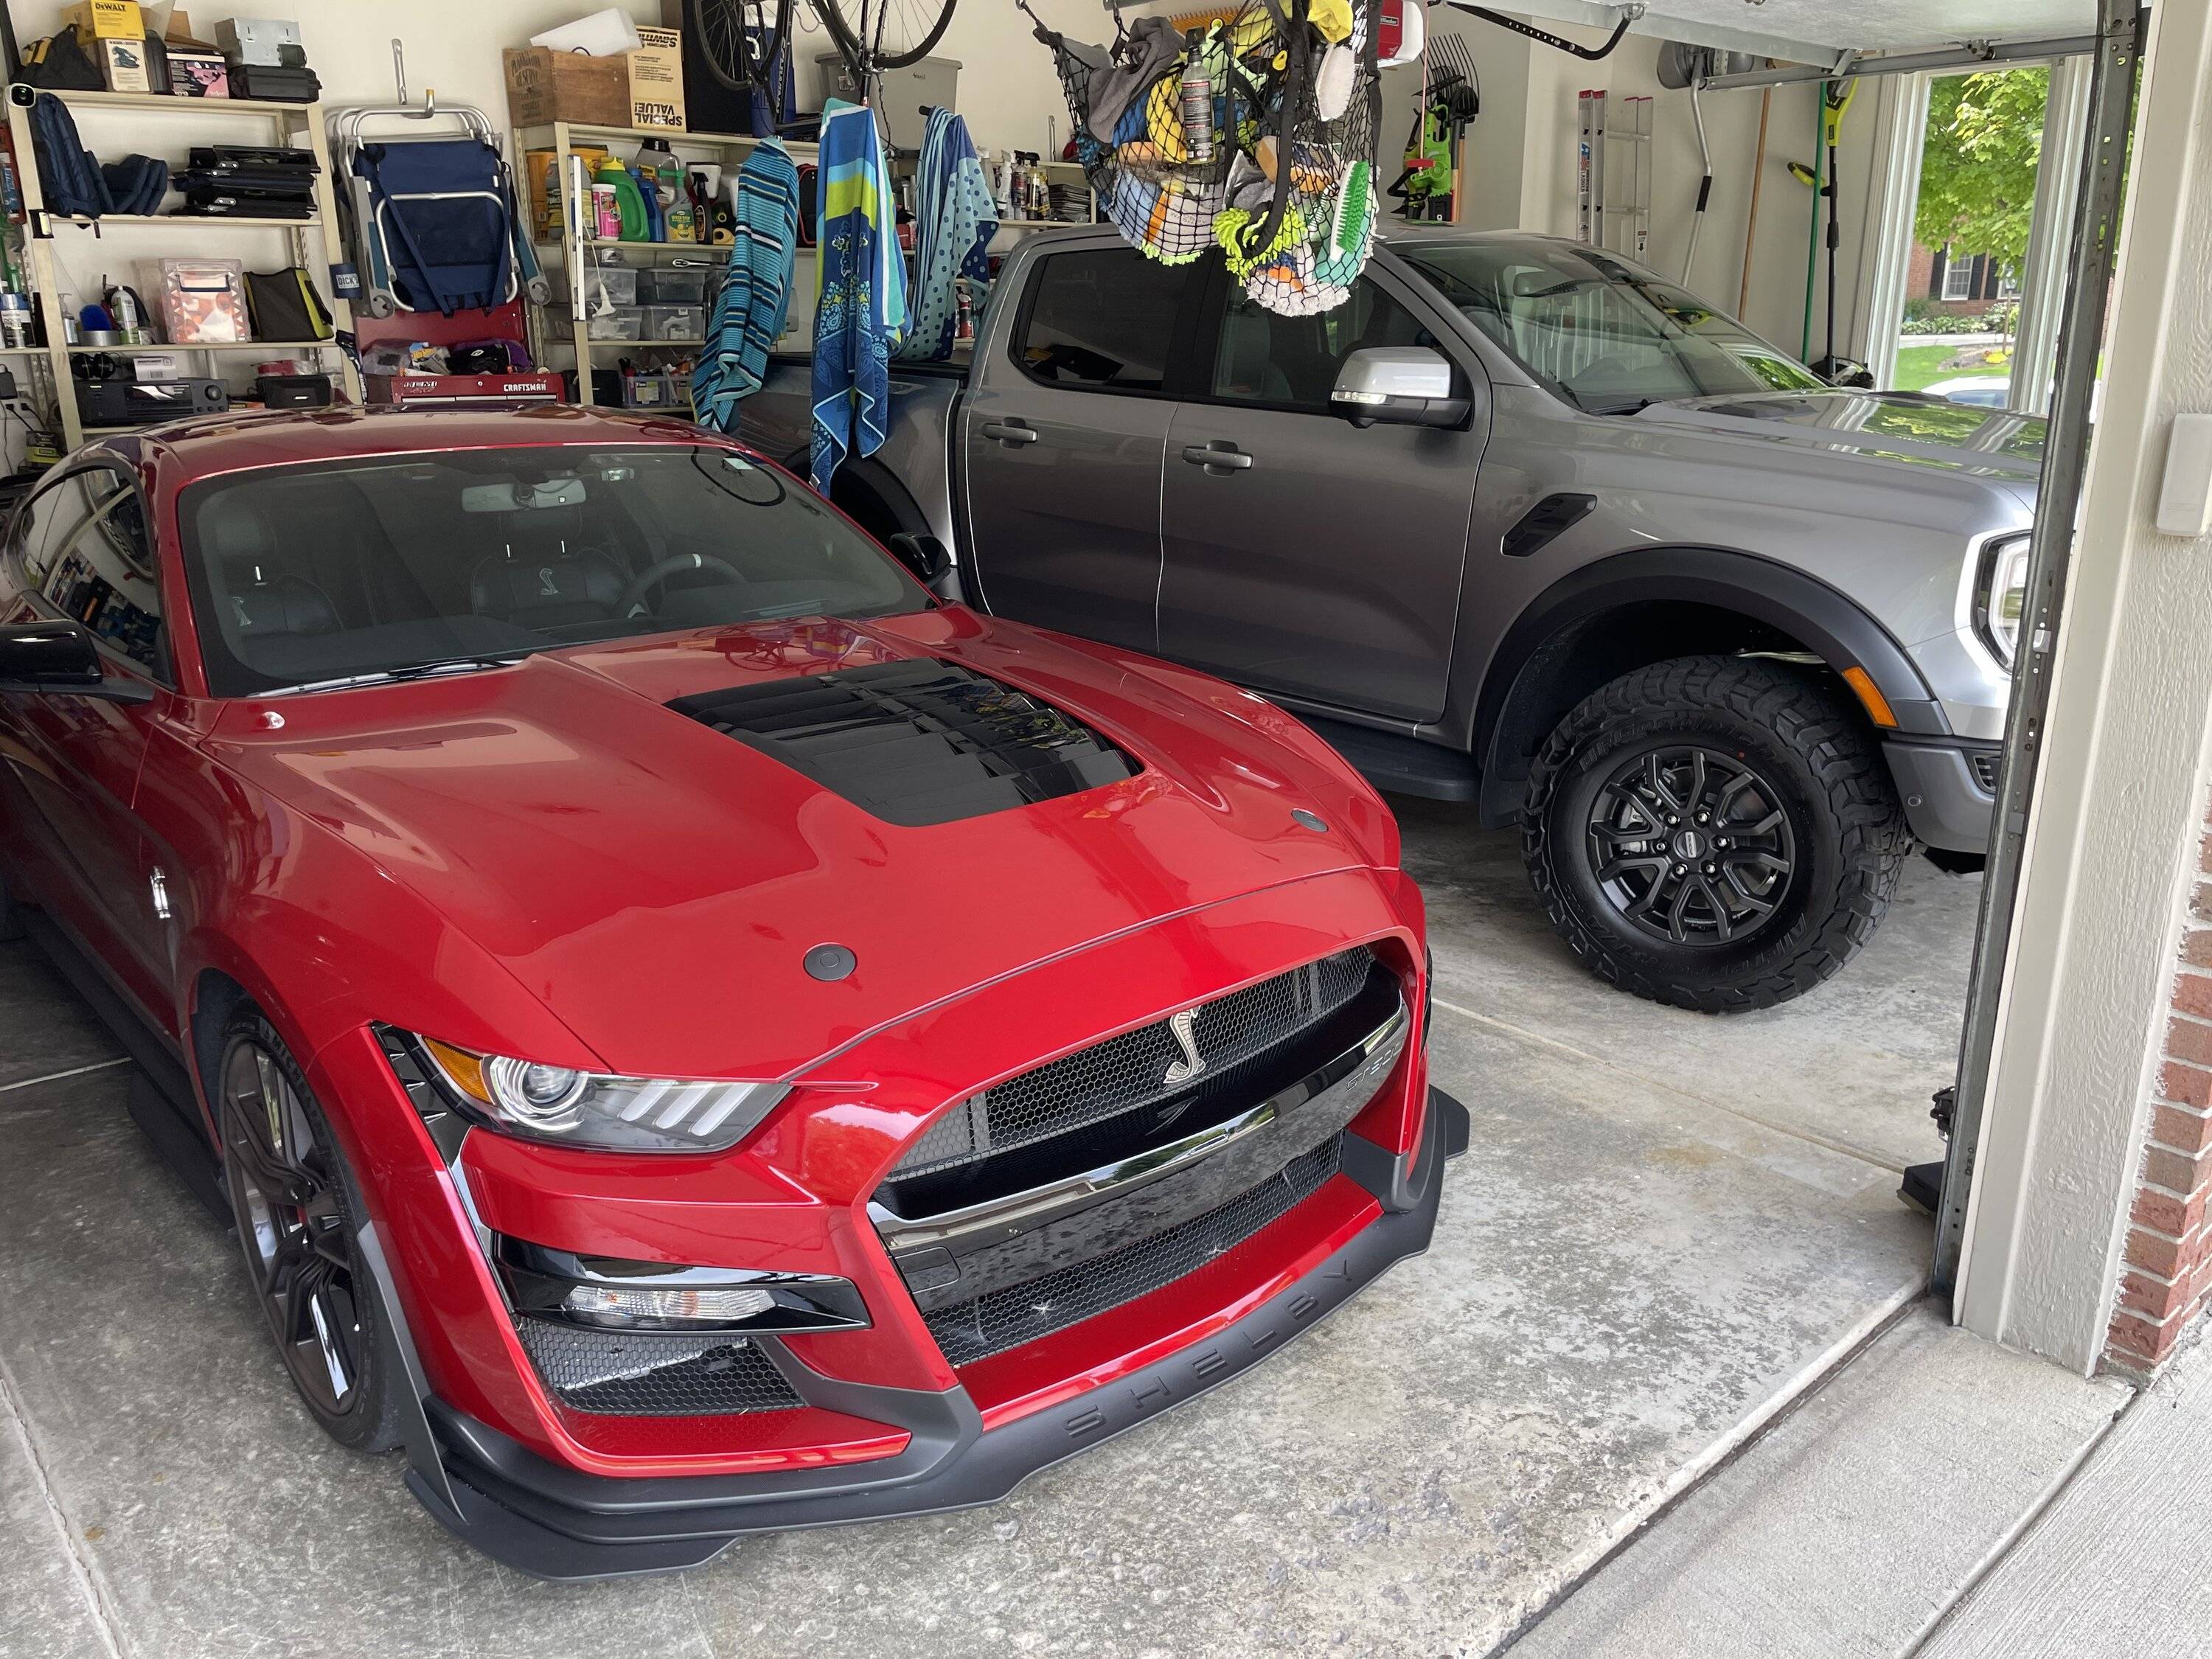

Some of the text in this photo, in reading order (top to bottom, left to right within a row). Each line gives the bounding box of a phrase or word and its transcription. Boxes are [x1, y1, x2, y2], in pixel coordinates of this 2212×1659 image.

[634, 102, 675, 116] VALUE!
[636, 111, 683, 127] SPECIAL
[503, 382, 547, 392] CRAFTSMAN
[1062, 1258, 1353, 1439] SHELBY
